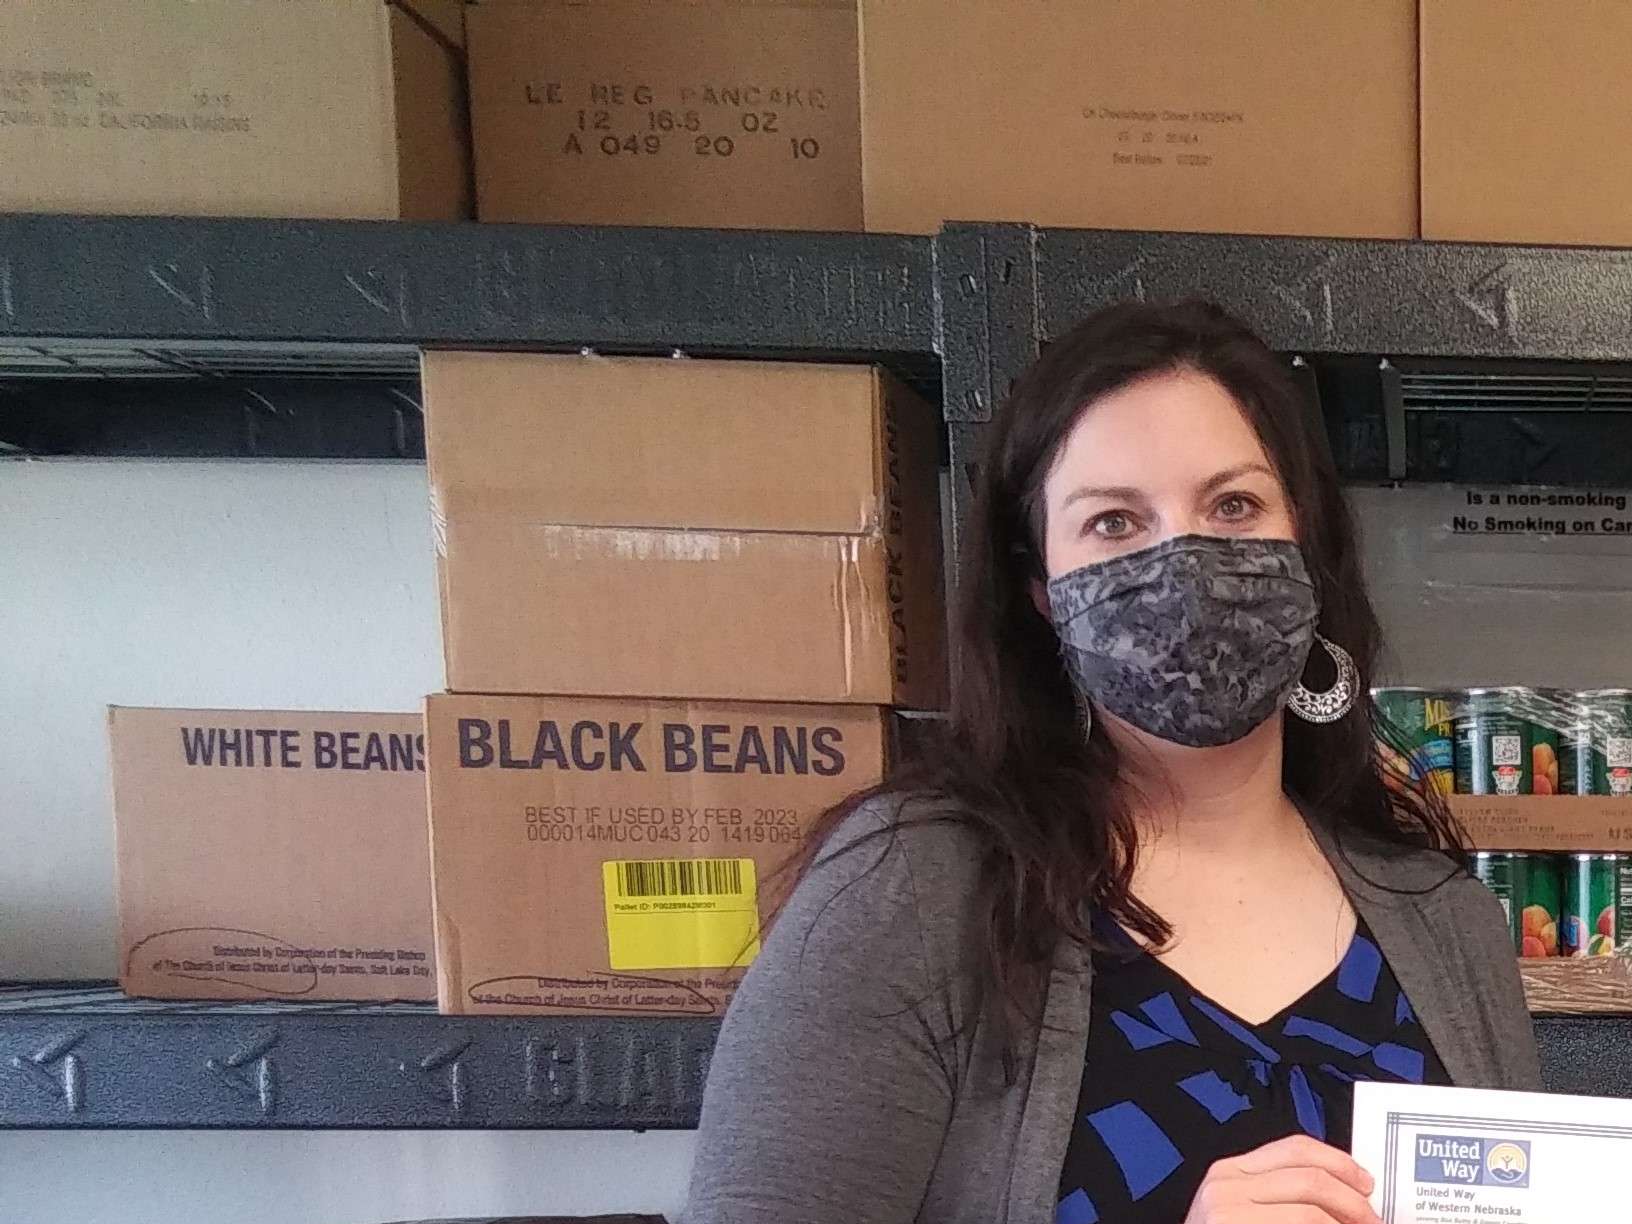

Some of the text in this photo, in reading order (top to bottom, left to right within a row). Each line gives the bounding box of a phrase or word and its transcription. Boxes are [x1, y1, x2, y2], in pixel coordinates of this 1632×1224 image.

[577, 110, 778, 133] 12 OZ
[564, 133, 820, 159] A 049 20 10
[1489, 494, 1499, 505] a
[1507, 491, 1626, 511] non-smoking
[1453, 516, 1478, 531] No
[1485, 516, 1566, 535] Smoking
[1573, 520, 1595, 532] on
[181, 727, 301, 769] WHITE
[458, 718, 846, 776] BLACK BEANS
[525, 806, 798, 826] BEST IF USED BY FEB 2023
[648, 825, 681, 842] 043
[688, 826, 710, 842] 20
[721, 826, 764, 843] 1419
[1418, 1139, 1481, 1159] United
[1441, 1159, 1480, 1183] Way
[1416, 1187, 1476, 1201] United Way
[1416, 1201, 1522, 1217] of Western Nebraska
